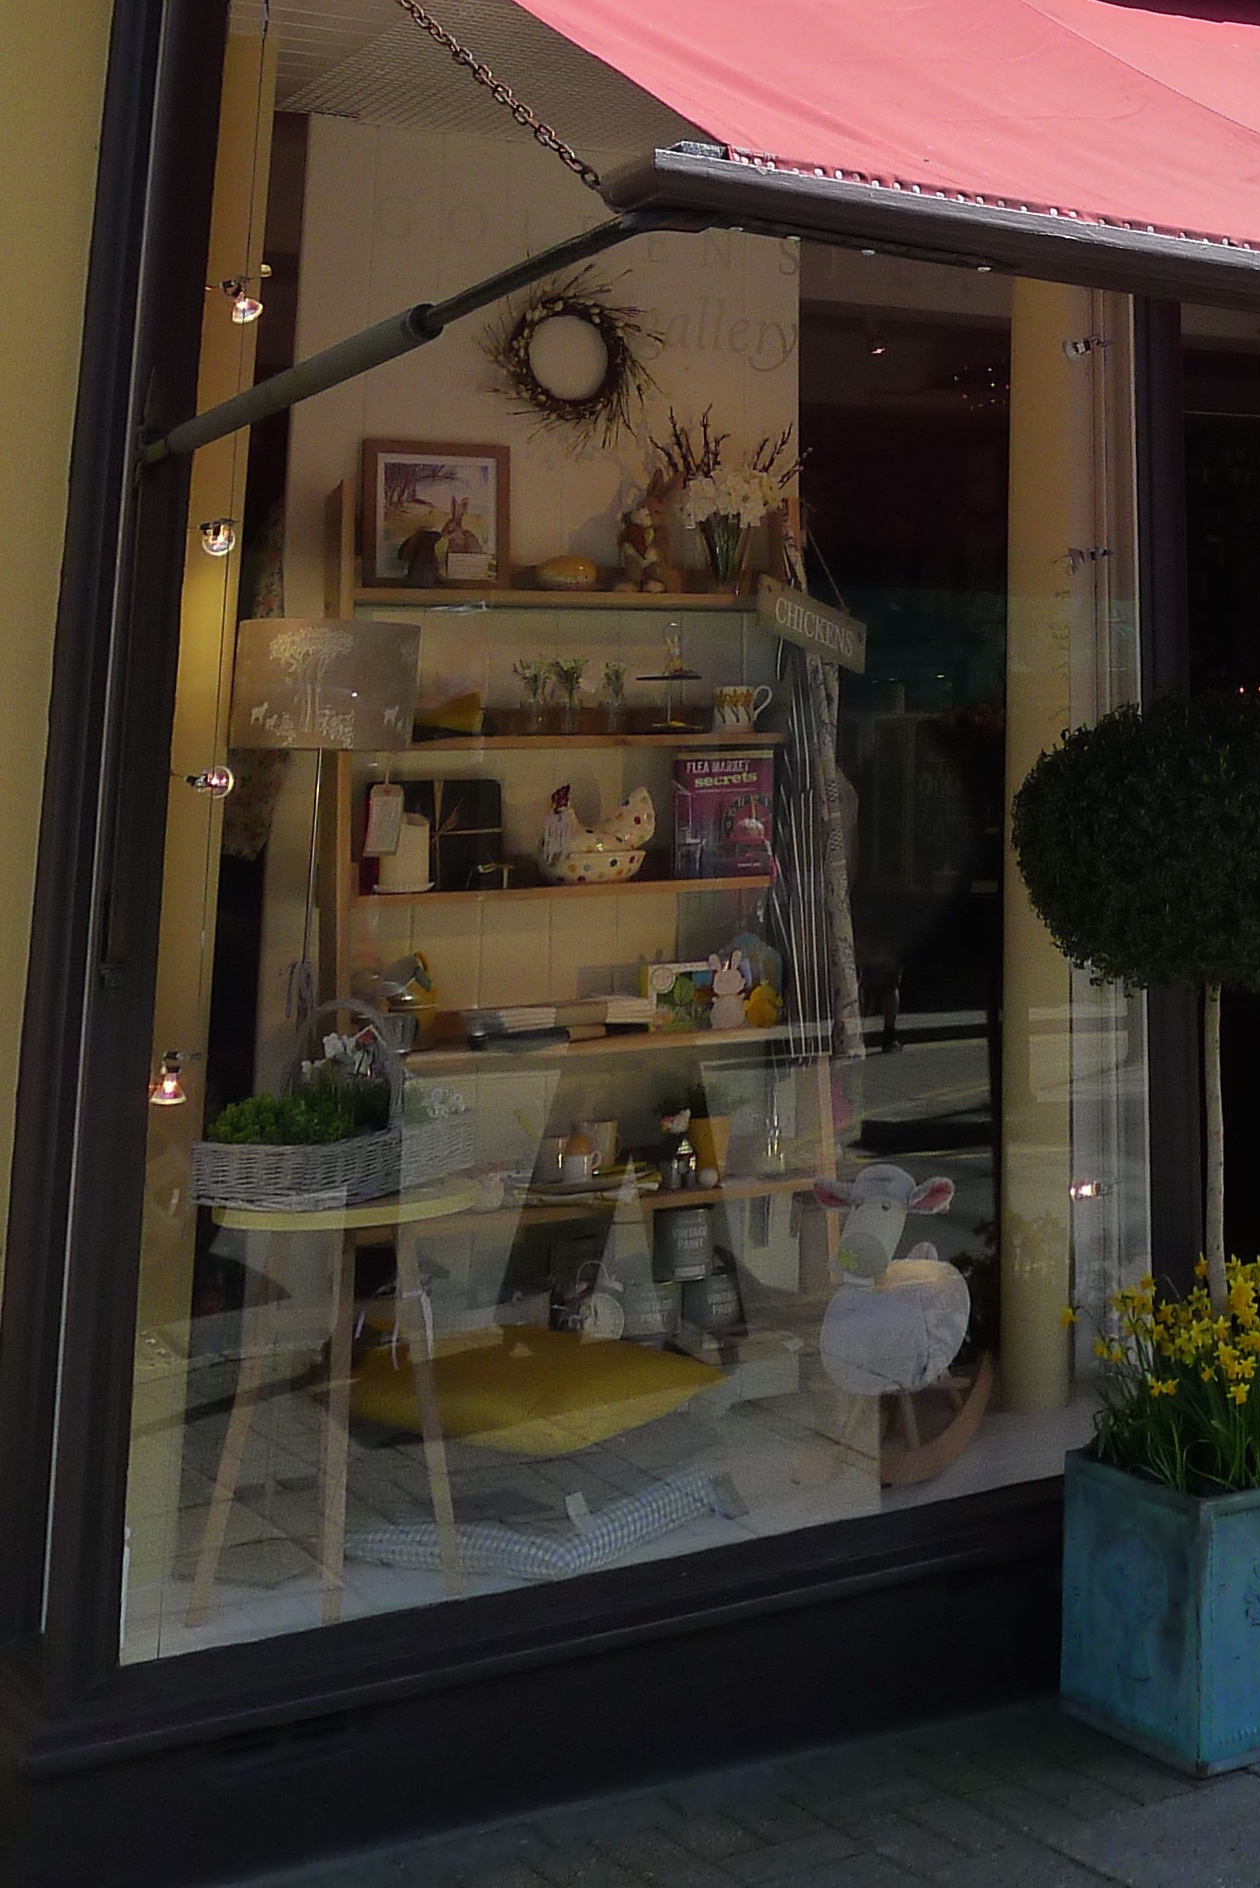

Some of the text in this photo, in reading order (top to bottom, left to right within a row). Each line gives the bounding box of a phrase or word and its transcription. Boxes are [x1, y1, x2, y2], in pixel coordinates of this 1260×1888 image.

[775, 596, 853, 657] CHICKENS
[686, 759, 751, 774] FLEA MARKET
[694, 771, 758, 788] secrets
[677, 1237, 703, 1251] PAINT
